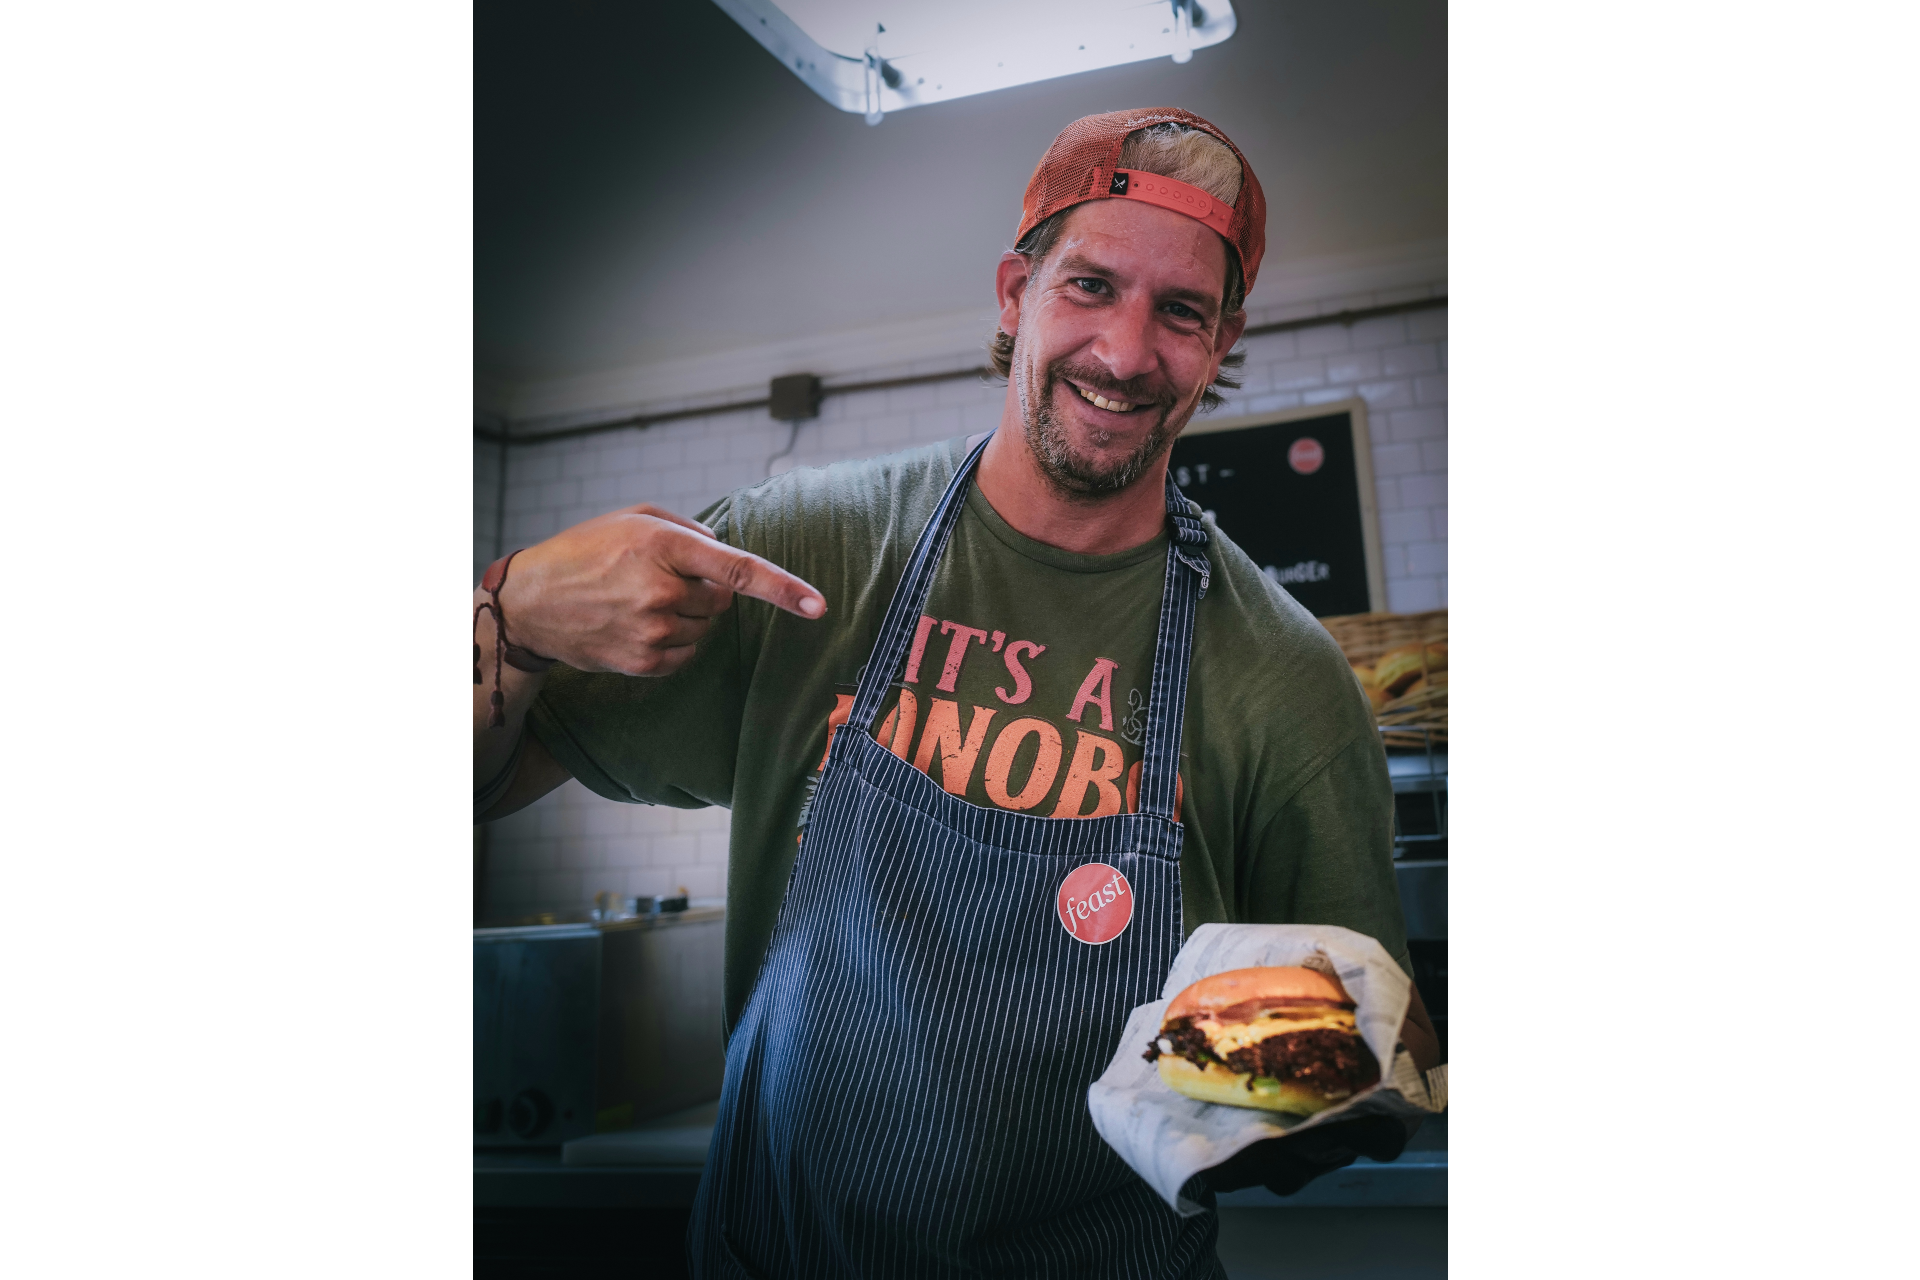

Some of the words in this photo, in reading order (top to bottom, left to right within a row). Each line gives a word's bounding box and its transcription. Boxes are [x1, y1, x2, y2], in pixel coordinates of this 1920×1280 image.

[904, 614, 1047, 705] IT'S
[1065, 657, 1120, 731] A
[1066, 874, 1126, 935] feast
